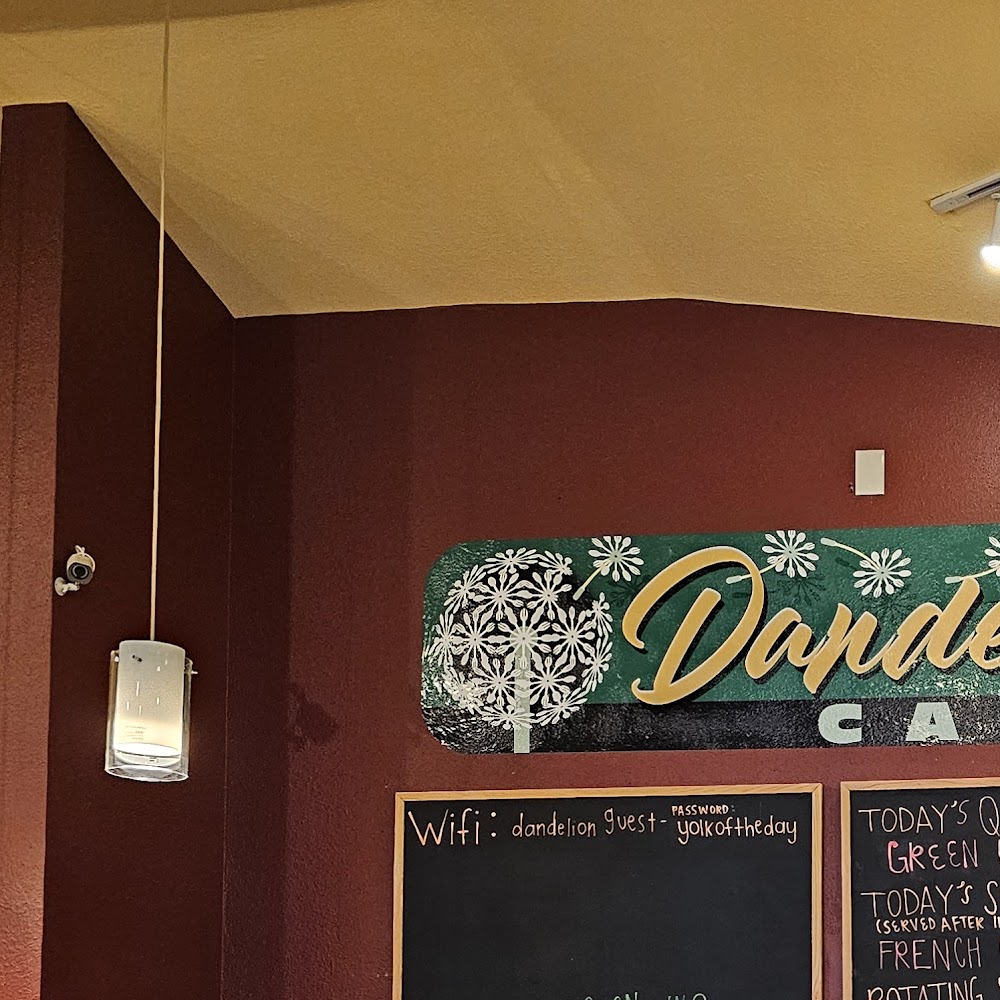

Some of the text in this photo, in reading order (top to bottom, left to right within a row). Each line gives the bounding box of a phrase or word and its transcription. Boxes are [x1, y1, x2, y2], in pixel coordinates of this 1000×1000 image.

[408, 808, 497, 847] Wifi:
[512, 811, 597, 839] dandelion
[671, 804, 736, 817] PASSWORD:
[858, 799, 970, 834] TODAY'S
[677, 816, 798, 846] yolkoftheday
[887, 839, 978, 875] GREEN
[861, 881, 972, 918] TODAY'S
[941, 915, 985, 932] AFTER
[879, 936, 982, 972] FRENCH
